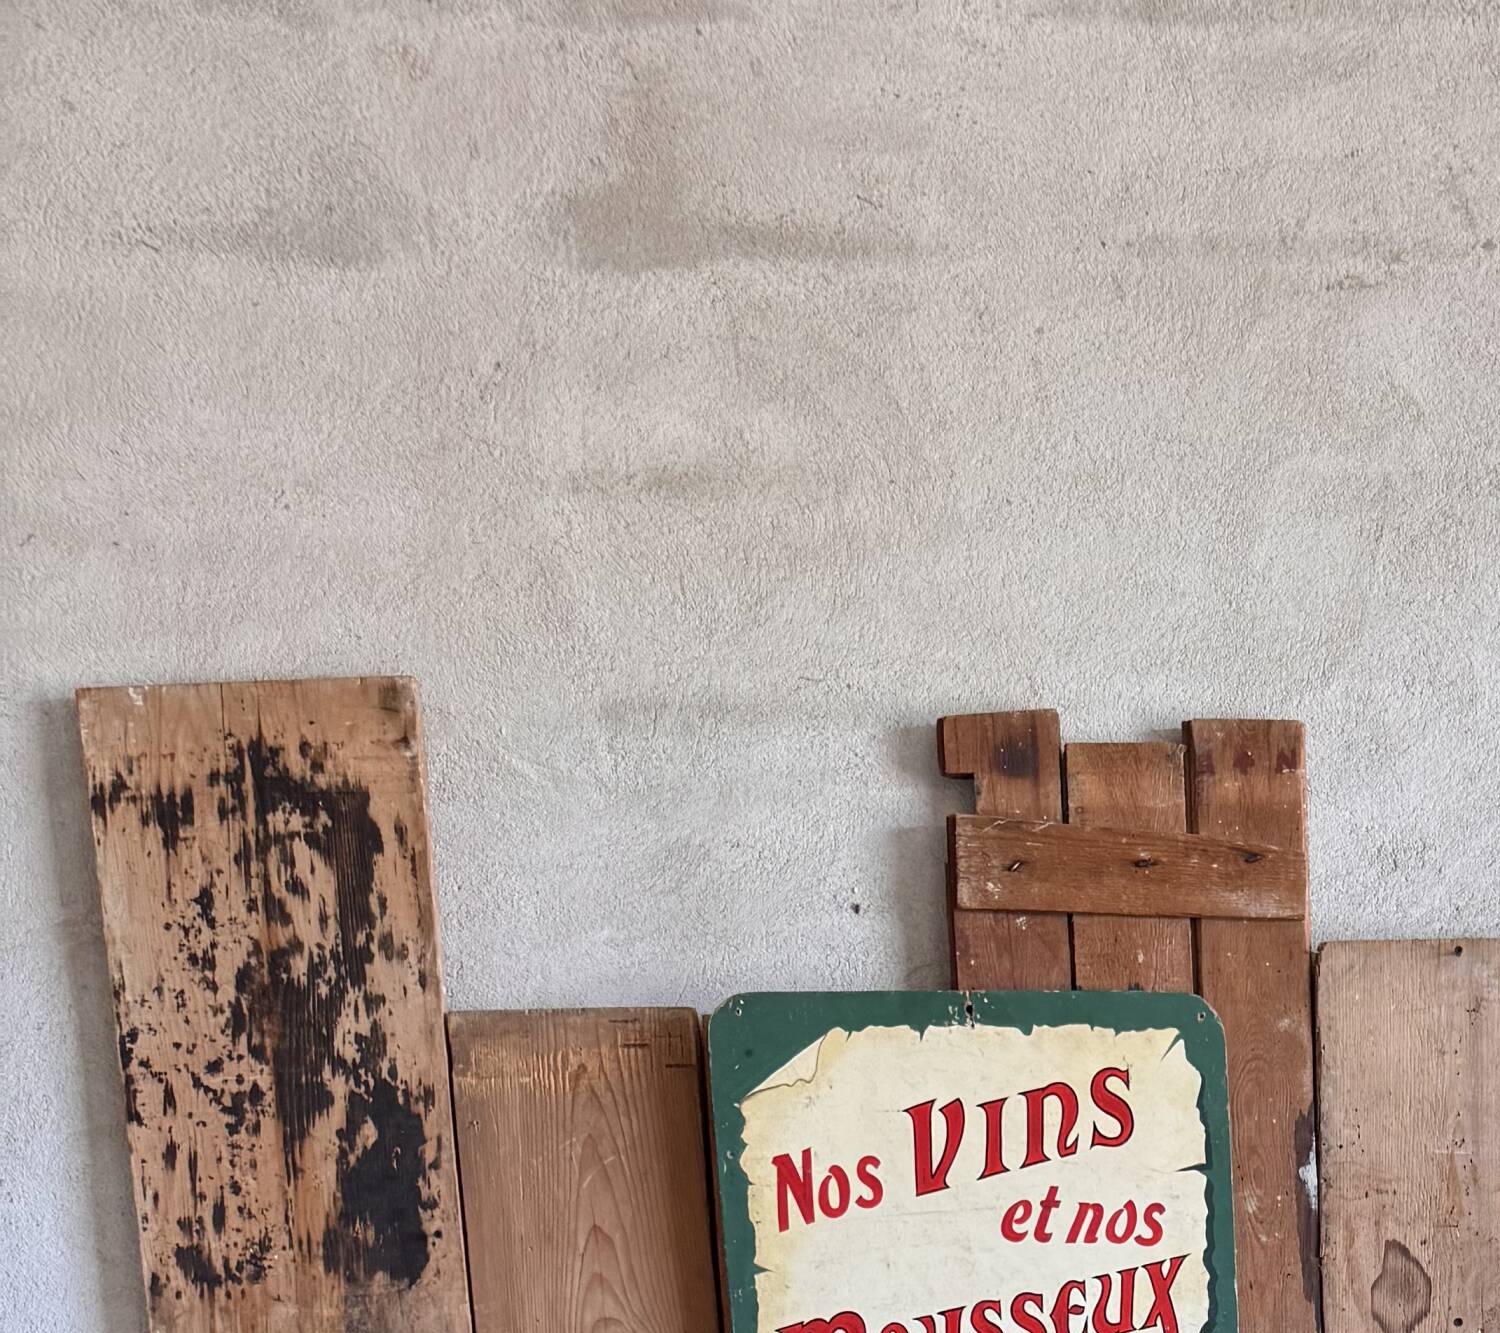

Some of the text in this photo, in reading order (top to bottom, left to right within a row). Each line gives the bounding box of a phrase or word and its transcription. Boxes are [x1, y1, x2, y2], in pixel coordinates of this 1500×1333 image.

[771, 1148, 883, 1233] Nos
[1000, 1186, 1165, 1247] et nos
